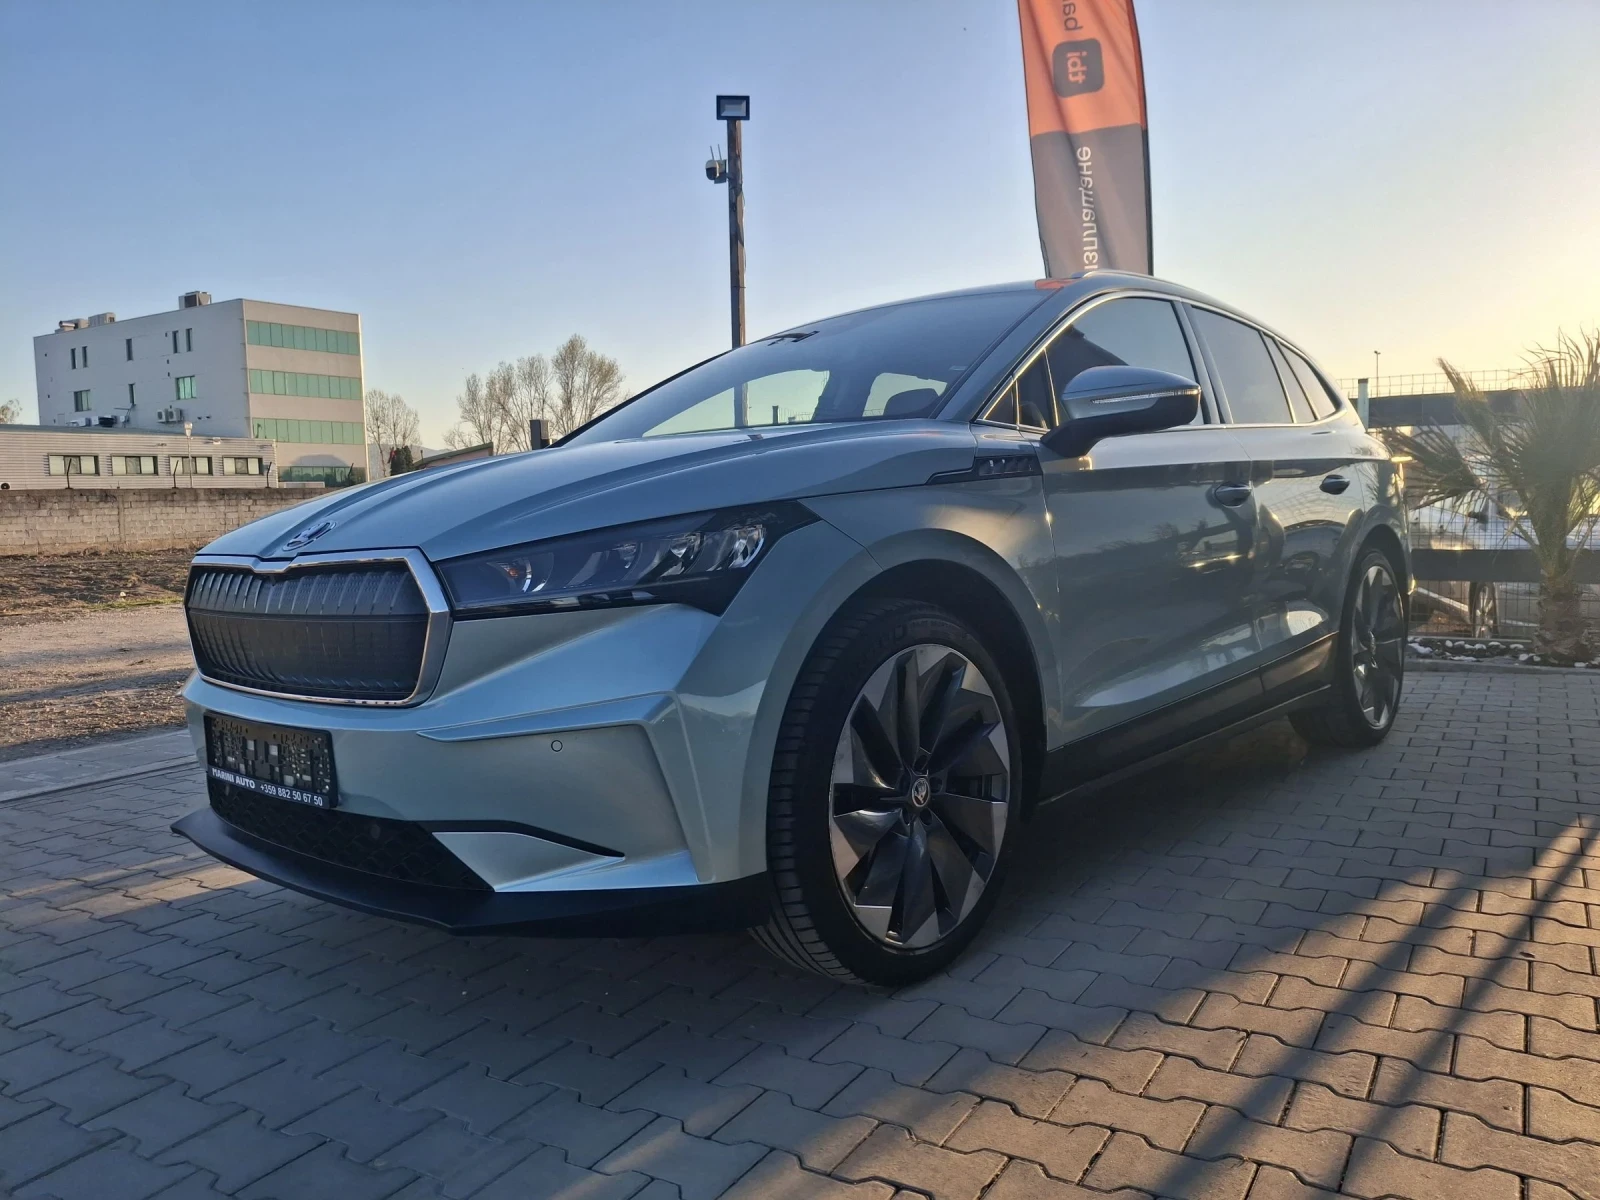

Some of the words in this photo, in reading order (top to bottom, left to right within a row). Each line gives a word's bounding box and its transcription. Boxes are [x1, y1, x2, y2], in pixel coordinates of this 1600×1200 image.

[235, 776, 255, 789] AUTO
[260, 784, 277, 795] +359
[278, 787, 291, 799] 882
[292, 791, 302, 801] 50
[303, 793, 312, 803] 67
[313, 797, 323, 806] 50
